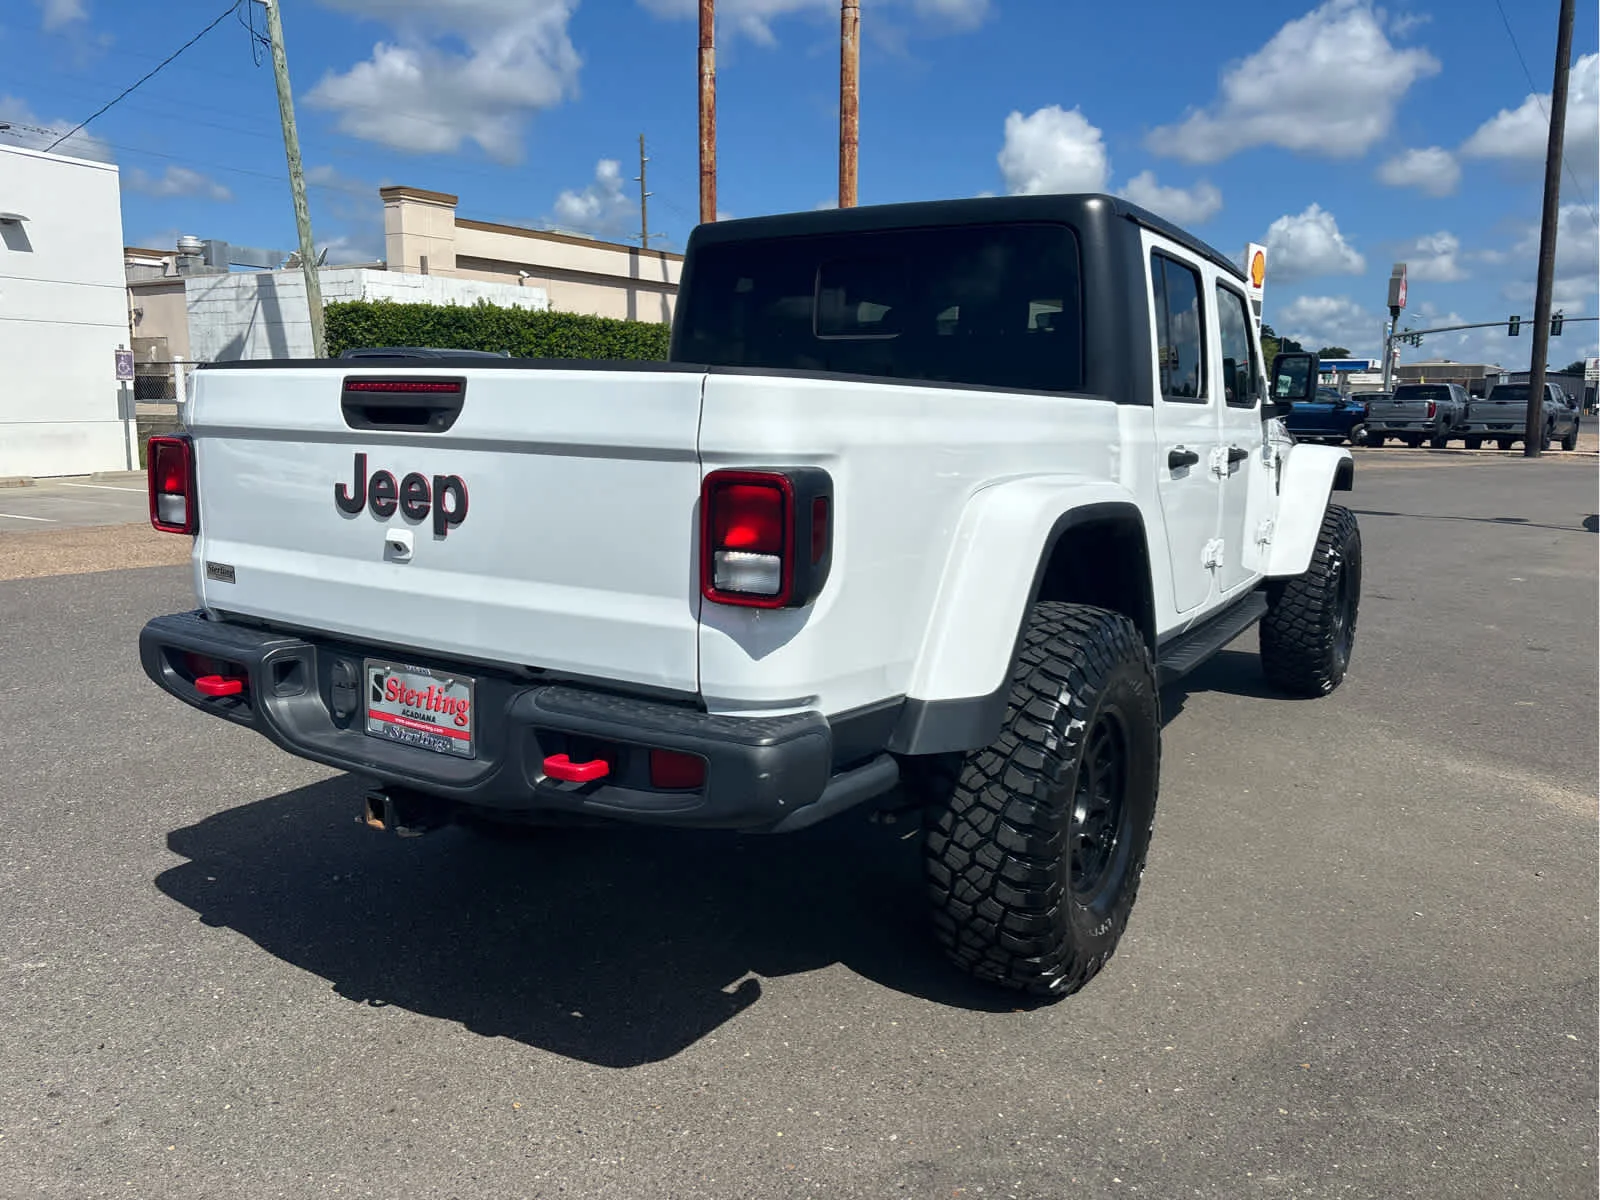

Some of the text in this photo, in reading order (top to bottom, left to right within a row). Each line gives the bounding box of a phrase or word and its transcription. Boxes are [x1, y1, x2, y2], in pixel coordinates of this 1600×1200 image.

[334, 453, 468, 536] Jeep
[385, 677, 470, 726] Sterling
[401, 709, 436, 723] ACADIANA
[390, 726, 446, 752] Sterling
